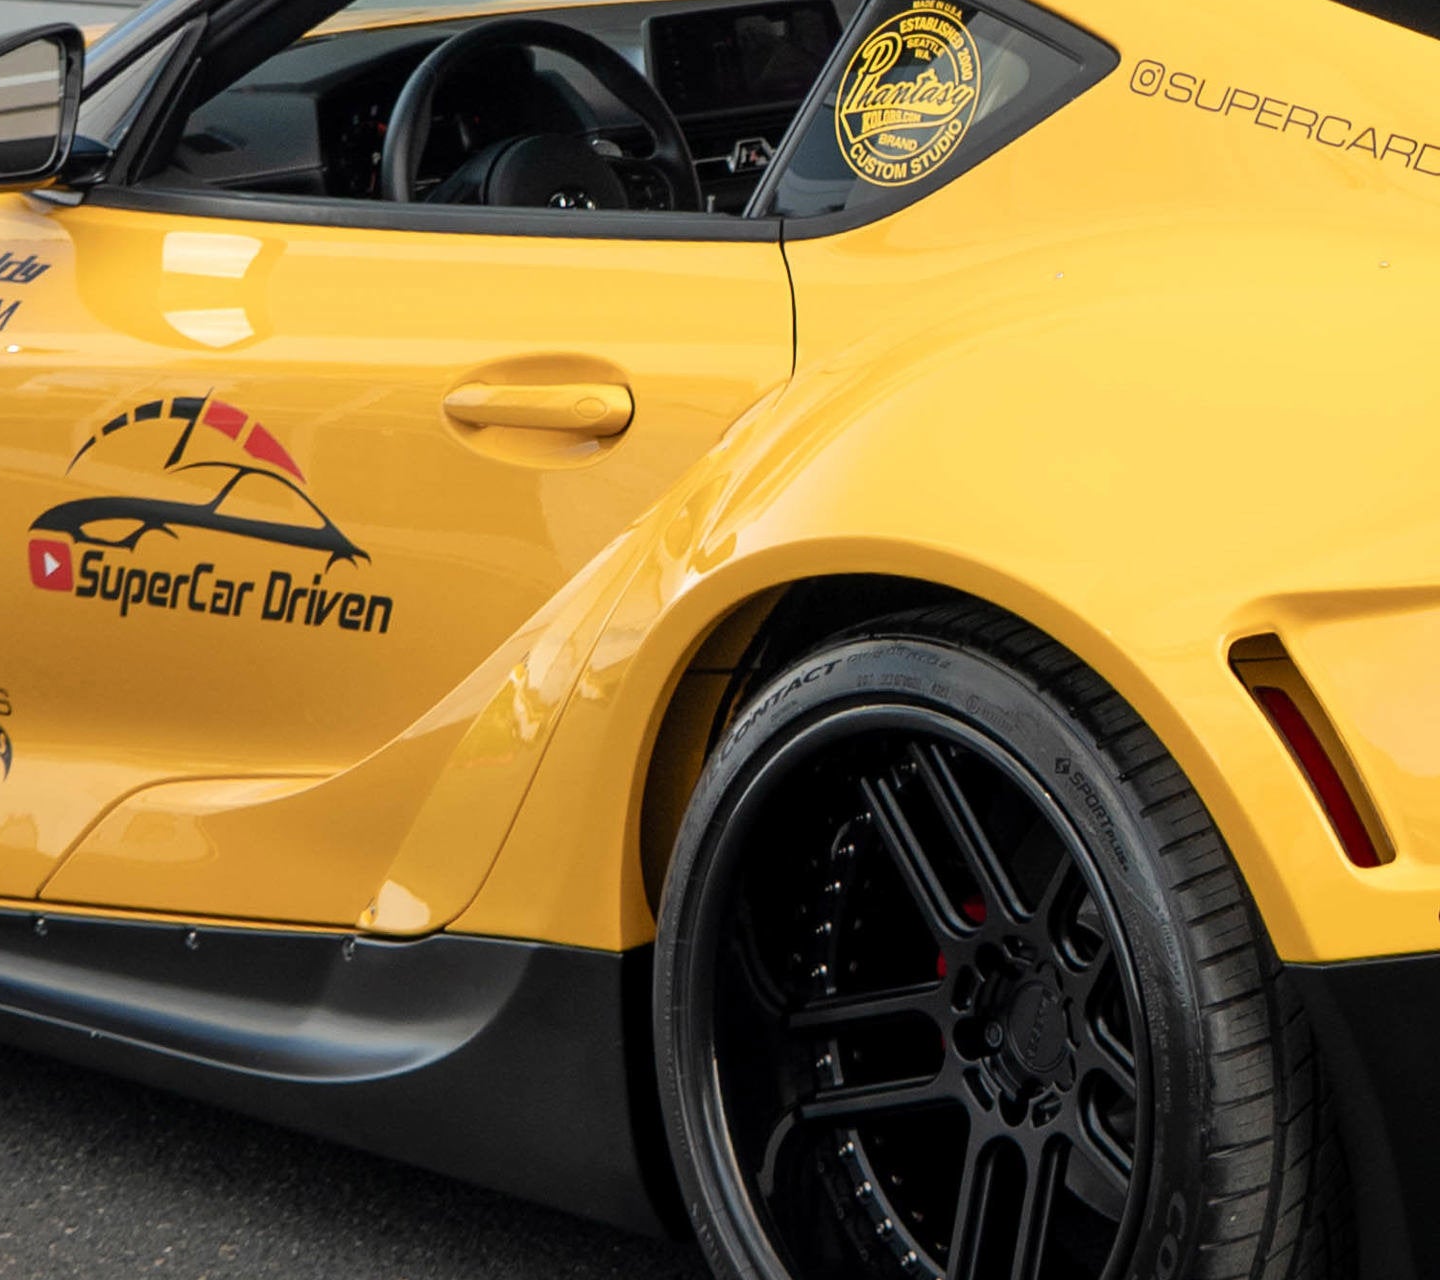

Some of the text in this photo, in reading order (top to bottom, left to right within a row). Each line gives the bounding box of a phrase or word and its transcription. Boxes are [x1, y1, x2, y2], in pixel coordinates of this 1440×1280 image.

[842, 32, 974, 116] Phantasy
[900, 16, 974, 81] ESTABLISHED 2000
[906, 38, 945, 58] SEATTLE
[850, 119, 962, 180] CUSTOM STUDIO
[878, 133, 918, 150] BRAND
[75, 550, 393, 634] SuperCar Driven
